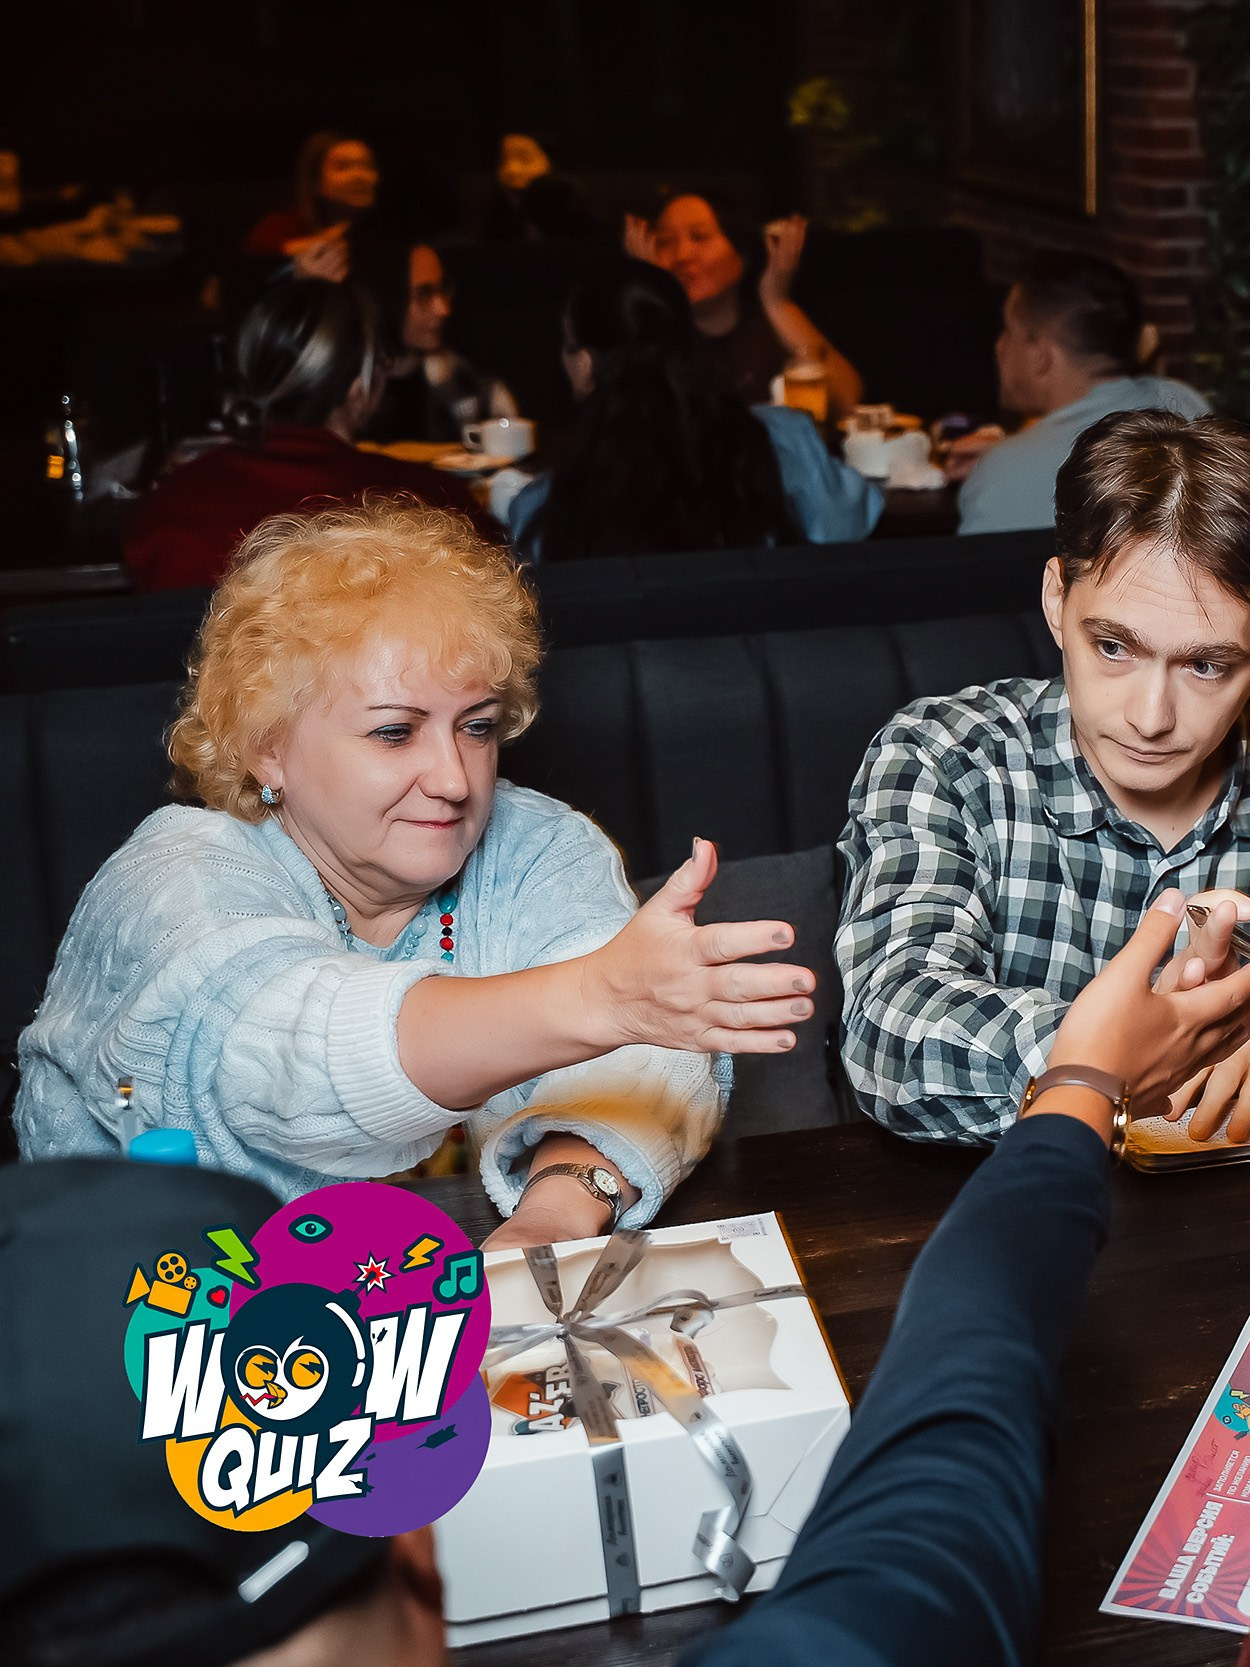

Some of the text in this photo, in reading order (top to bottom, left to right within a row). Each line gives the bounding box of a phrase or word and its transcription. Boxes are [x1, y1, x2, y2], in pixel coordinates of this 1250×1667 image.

[1158, 1555, 1197, 1599] ВАША
[1182, 1500, 1223, 1554] ВЕРСИЯ
[1186, 1533, 1235, 1603] СОБЫТИЙ:
